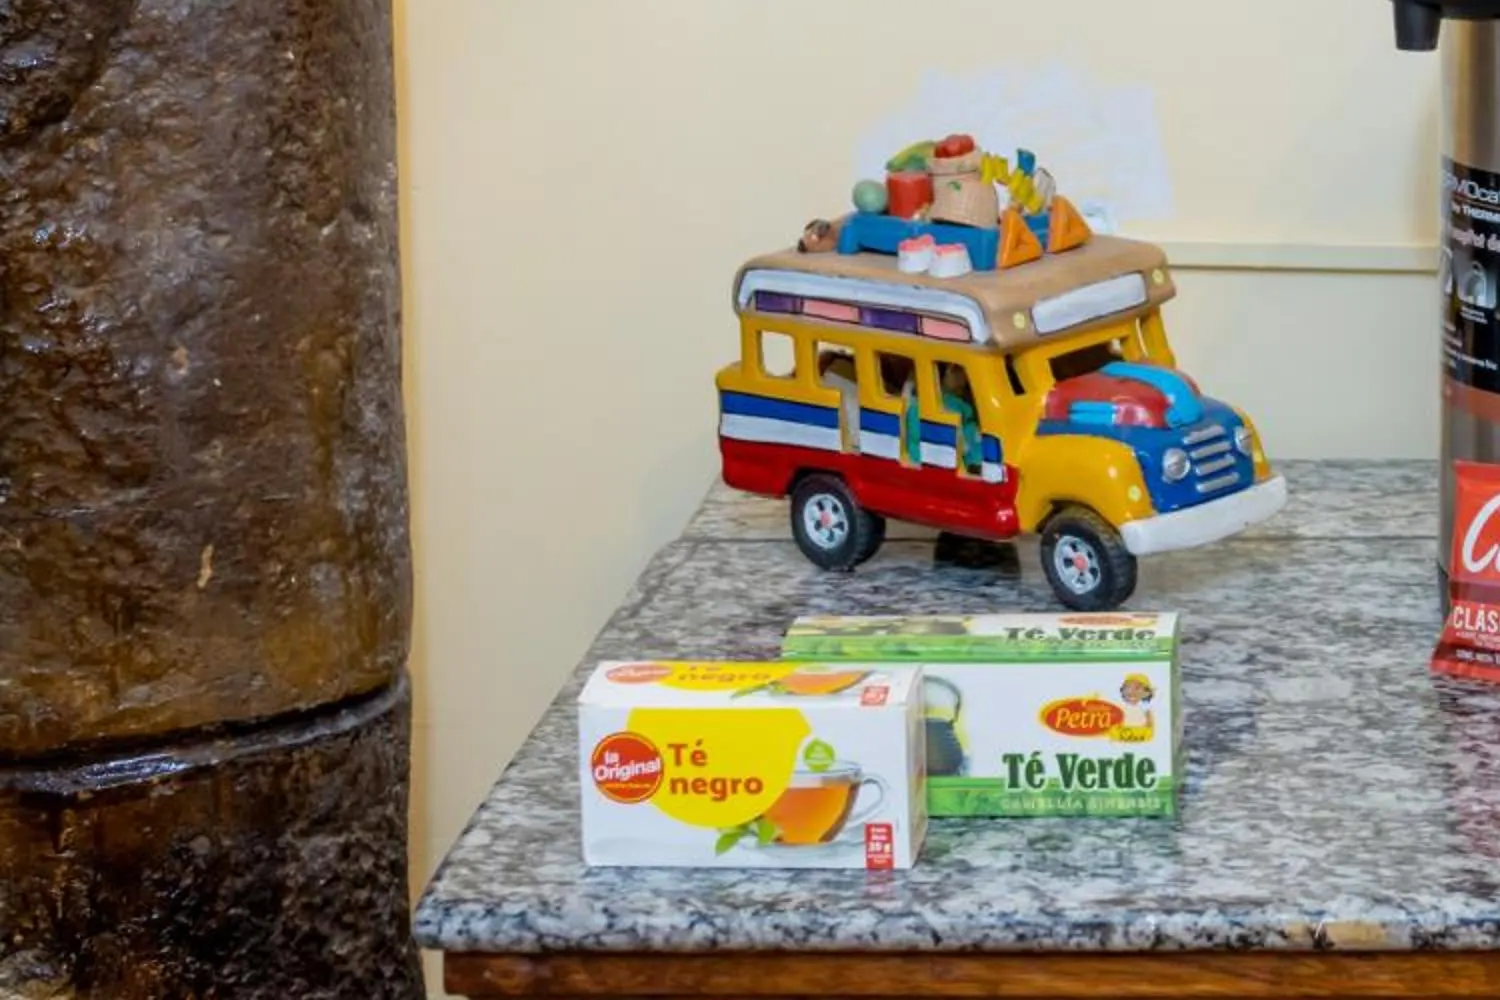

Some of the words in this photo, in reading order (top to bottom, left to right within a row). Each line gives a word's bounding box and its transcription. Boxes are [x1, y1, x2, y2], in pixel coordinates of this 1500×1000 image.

[1057, 626, 1156, 641] Verde
[1055, 705, 1111, 729] Petra
[667, 738, 708, 767] Té
[594, 757, 661, 782] Original
[1002, 751, 1046, 790] Té
[1055, 751, 1157, 790] Verde
[669, 776, 764, 802] negro
